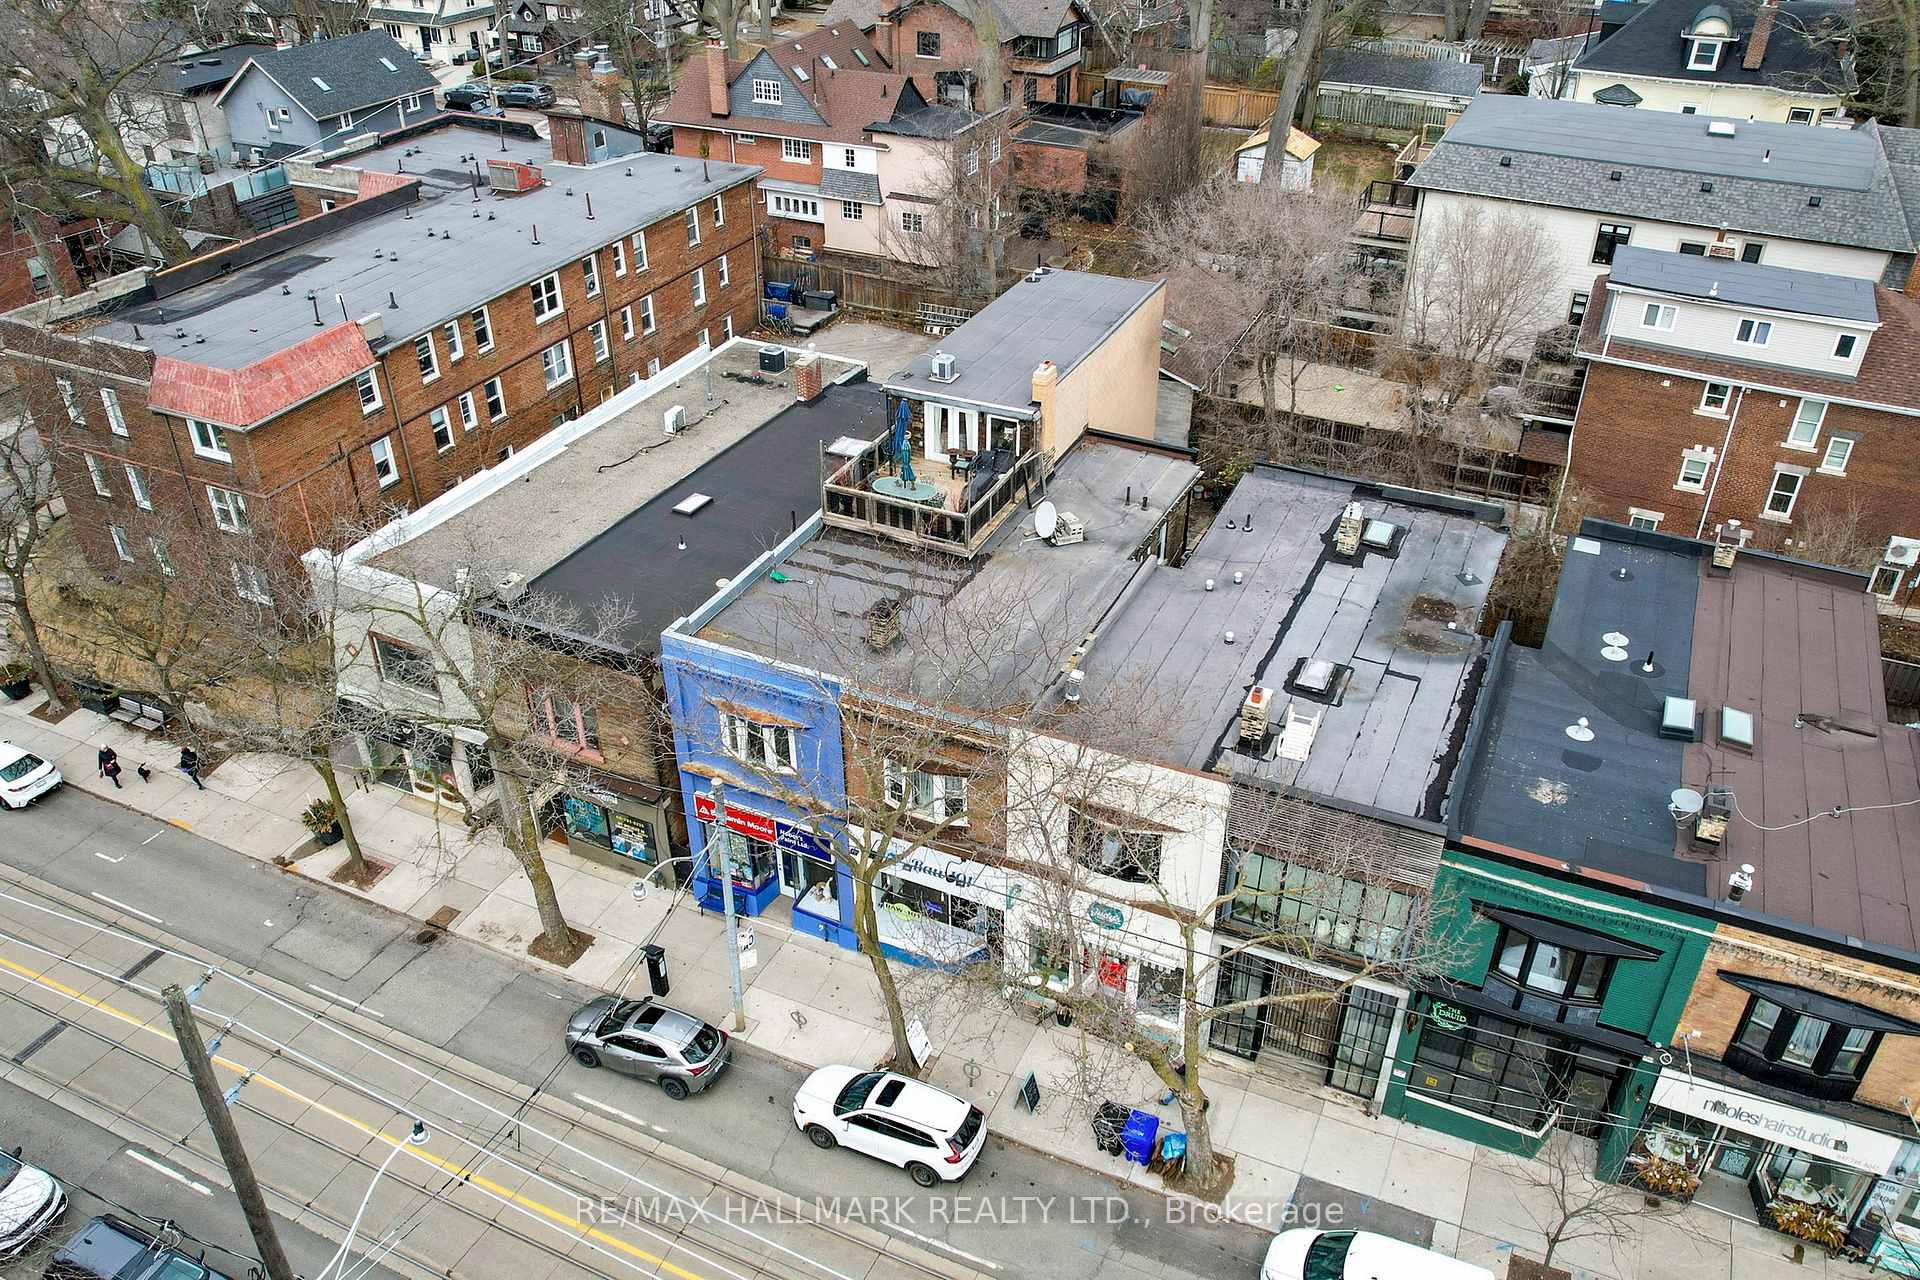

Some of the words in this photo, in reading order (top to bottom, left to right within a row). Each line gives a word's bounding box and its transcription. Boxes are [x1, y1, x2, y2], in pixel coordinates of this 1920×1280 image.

[747, 820, 774, 835] Moore
[1439, 1009, 1467, 1023] DRUID
[1447, 1006, 1461, 1015] THE
